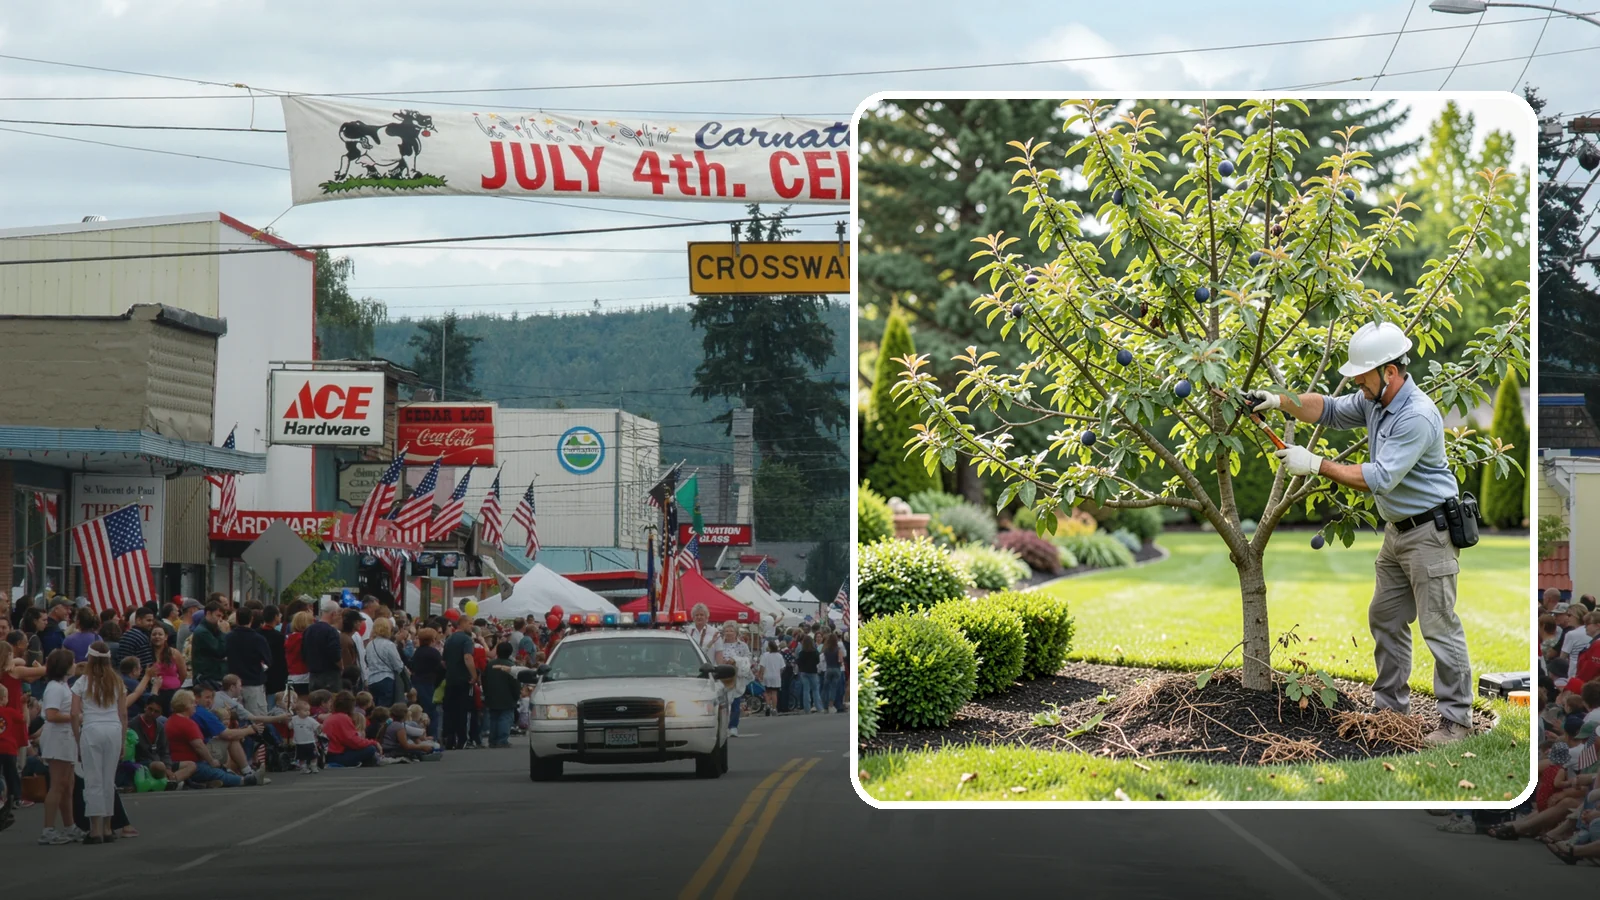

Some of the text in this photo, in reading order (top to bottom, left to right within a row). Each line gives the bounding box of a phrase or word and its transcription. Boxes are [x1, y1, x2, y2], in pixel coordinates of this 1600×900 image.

[481, 141, 605, 193] JULY
[632, 150, 746, 198] 4th.
[697, 254, 850, 280] CROSSWA
[283, 380, 374, 420] ACE
[406, 409, 453, 422] CEDAR
[283, 421, 371, 436] Hardware
[416, 428, 477, 447] Coca-Cola
[353, 466, 384, 480] Simpl
[83, 485, 155, 495] St. Vincent de Paul
[688, 526, 742, 535] CRNATION
[699, 535, 730, 543] GLASS
